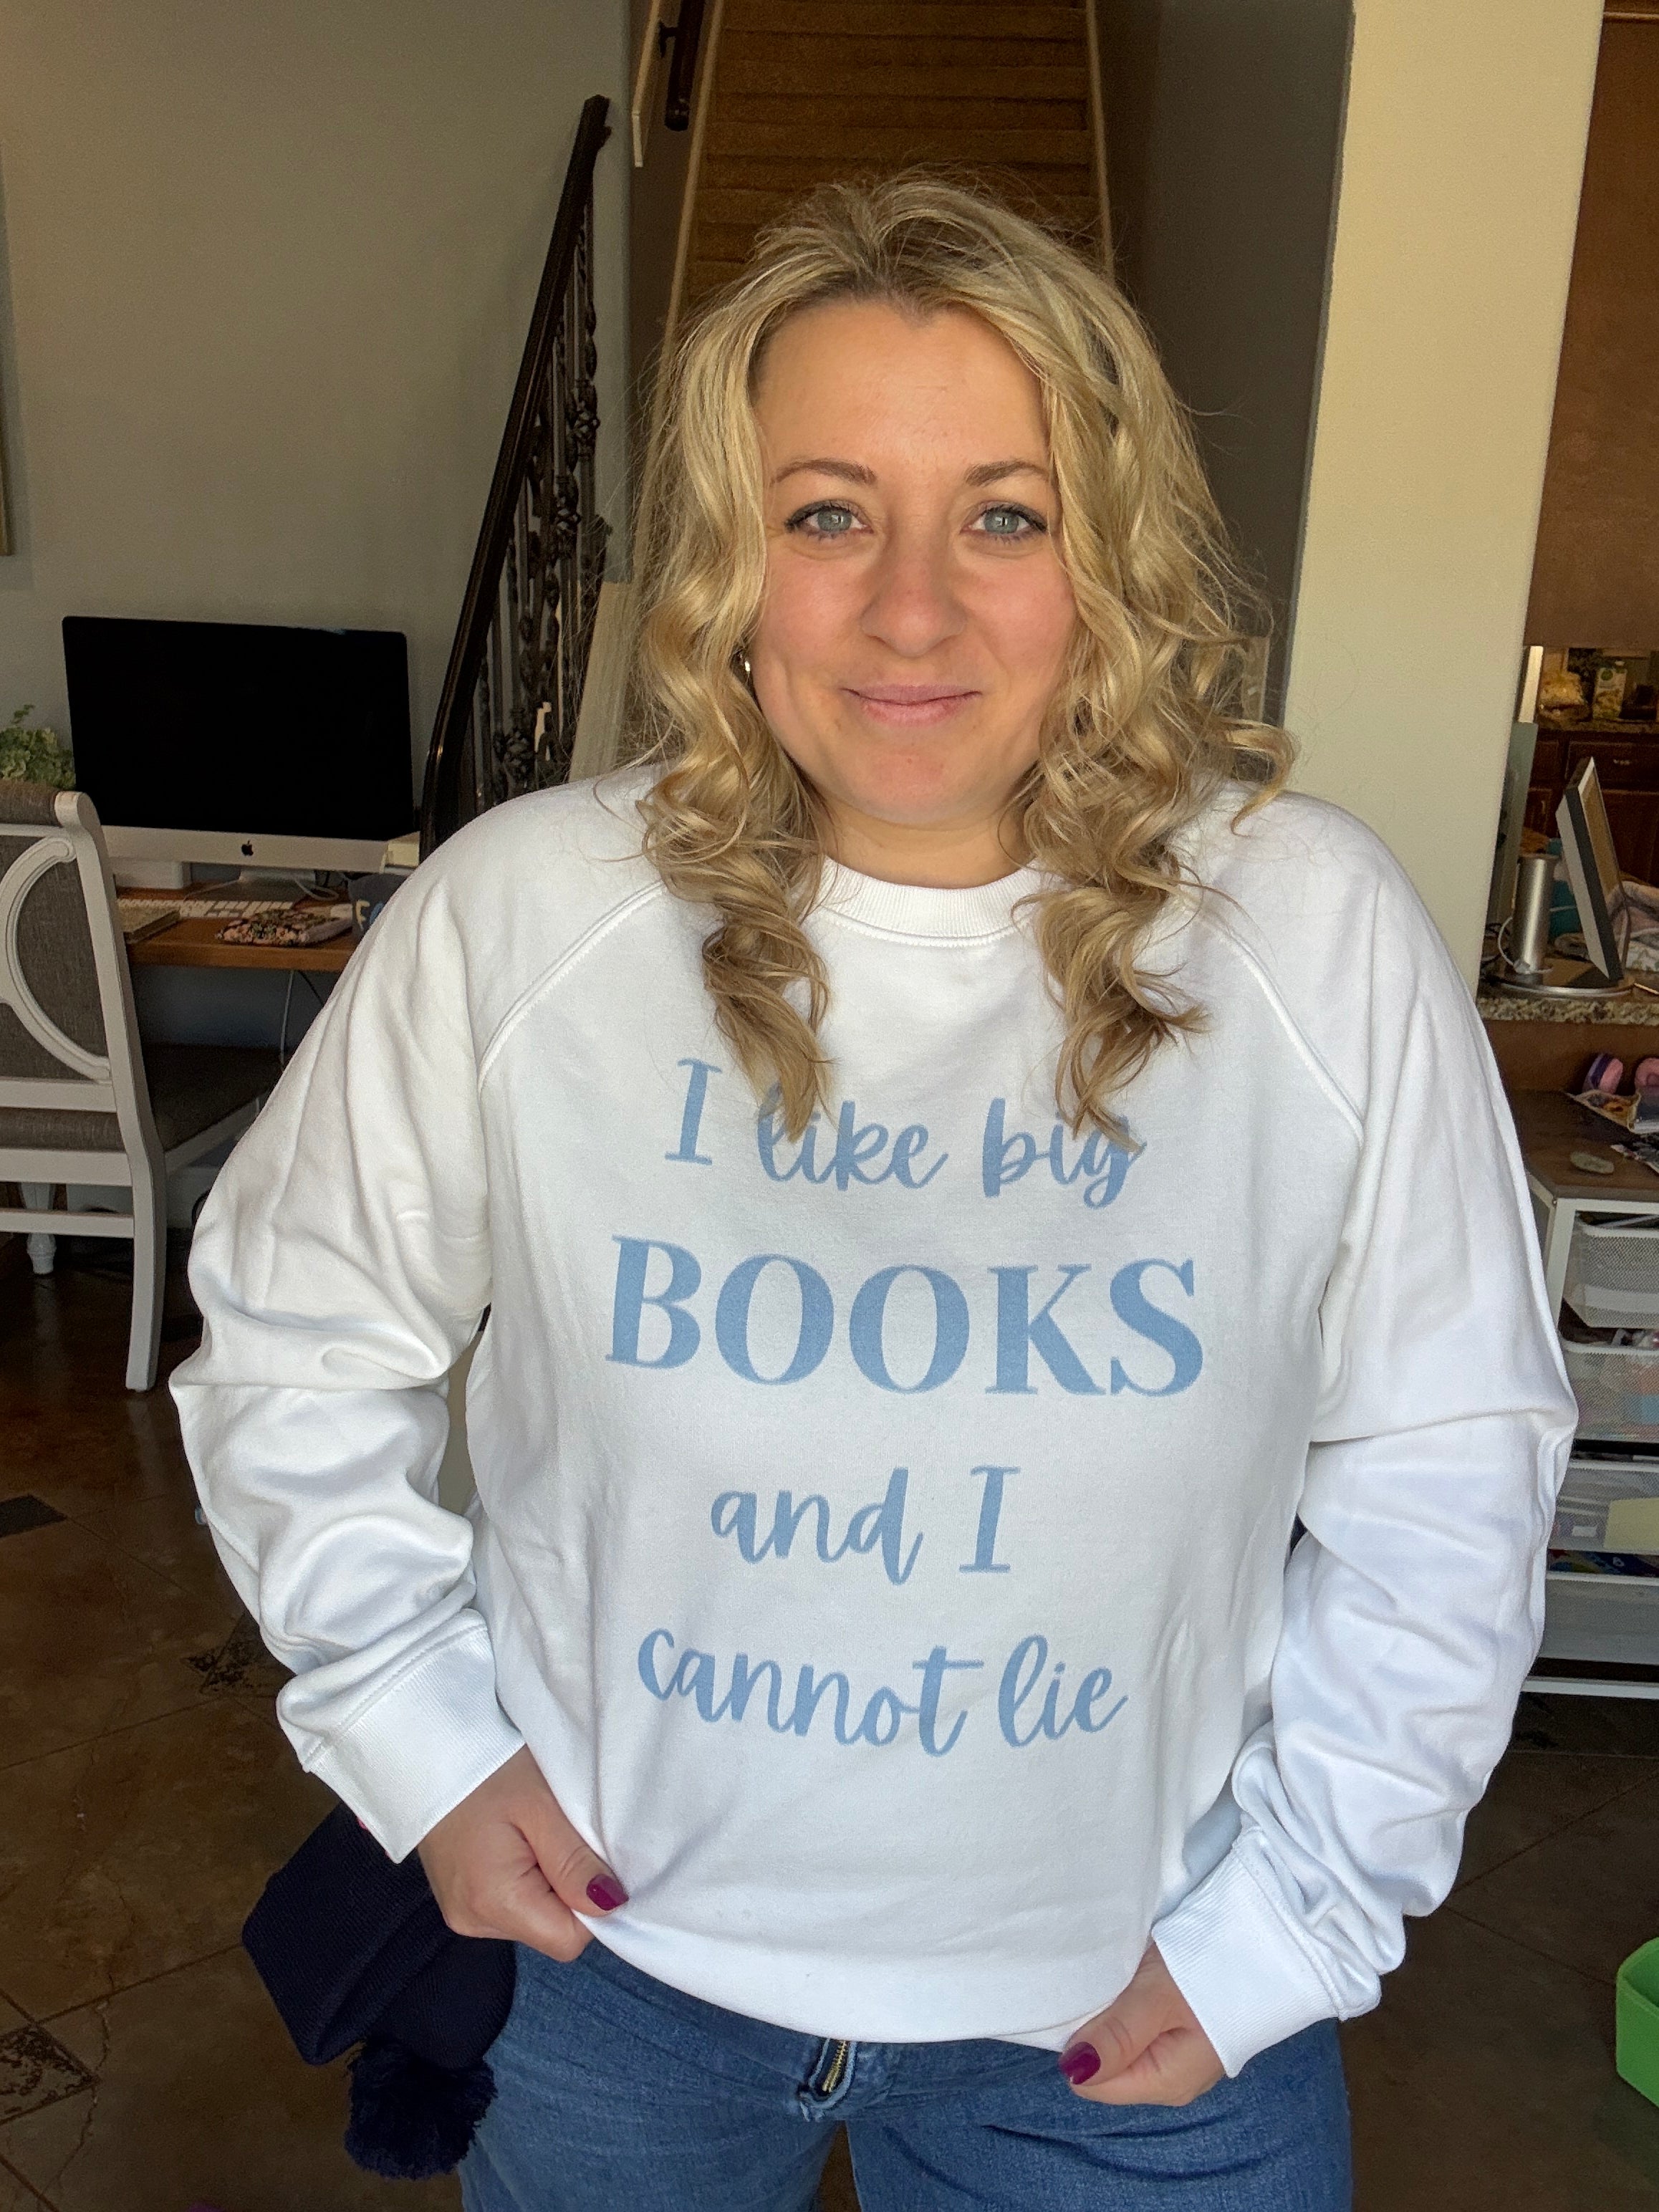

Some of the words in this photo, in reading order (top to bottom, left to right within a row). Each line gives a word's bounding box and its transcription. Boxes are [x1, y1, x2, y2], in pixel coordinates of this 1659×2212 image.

[665, 1057, 722, 1165] I
[756, 1081, 949, 1192] like
[982, 1096, 1148, 1209] big
[605, 1234, 1204, 1397] BOOKS
[710, 1466, 923, 1585] and
[958, 1466, 1021, 1573] I
[638, 1627, 984, 1756] cannot
[997, 1633, 1129, 1747] lie
